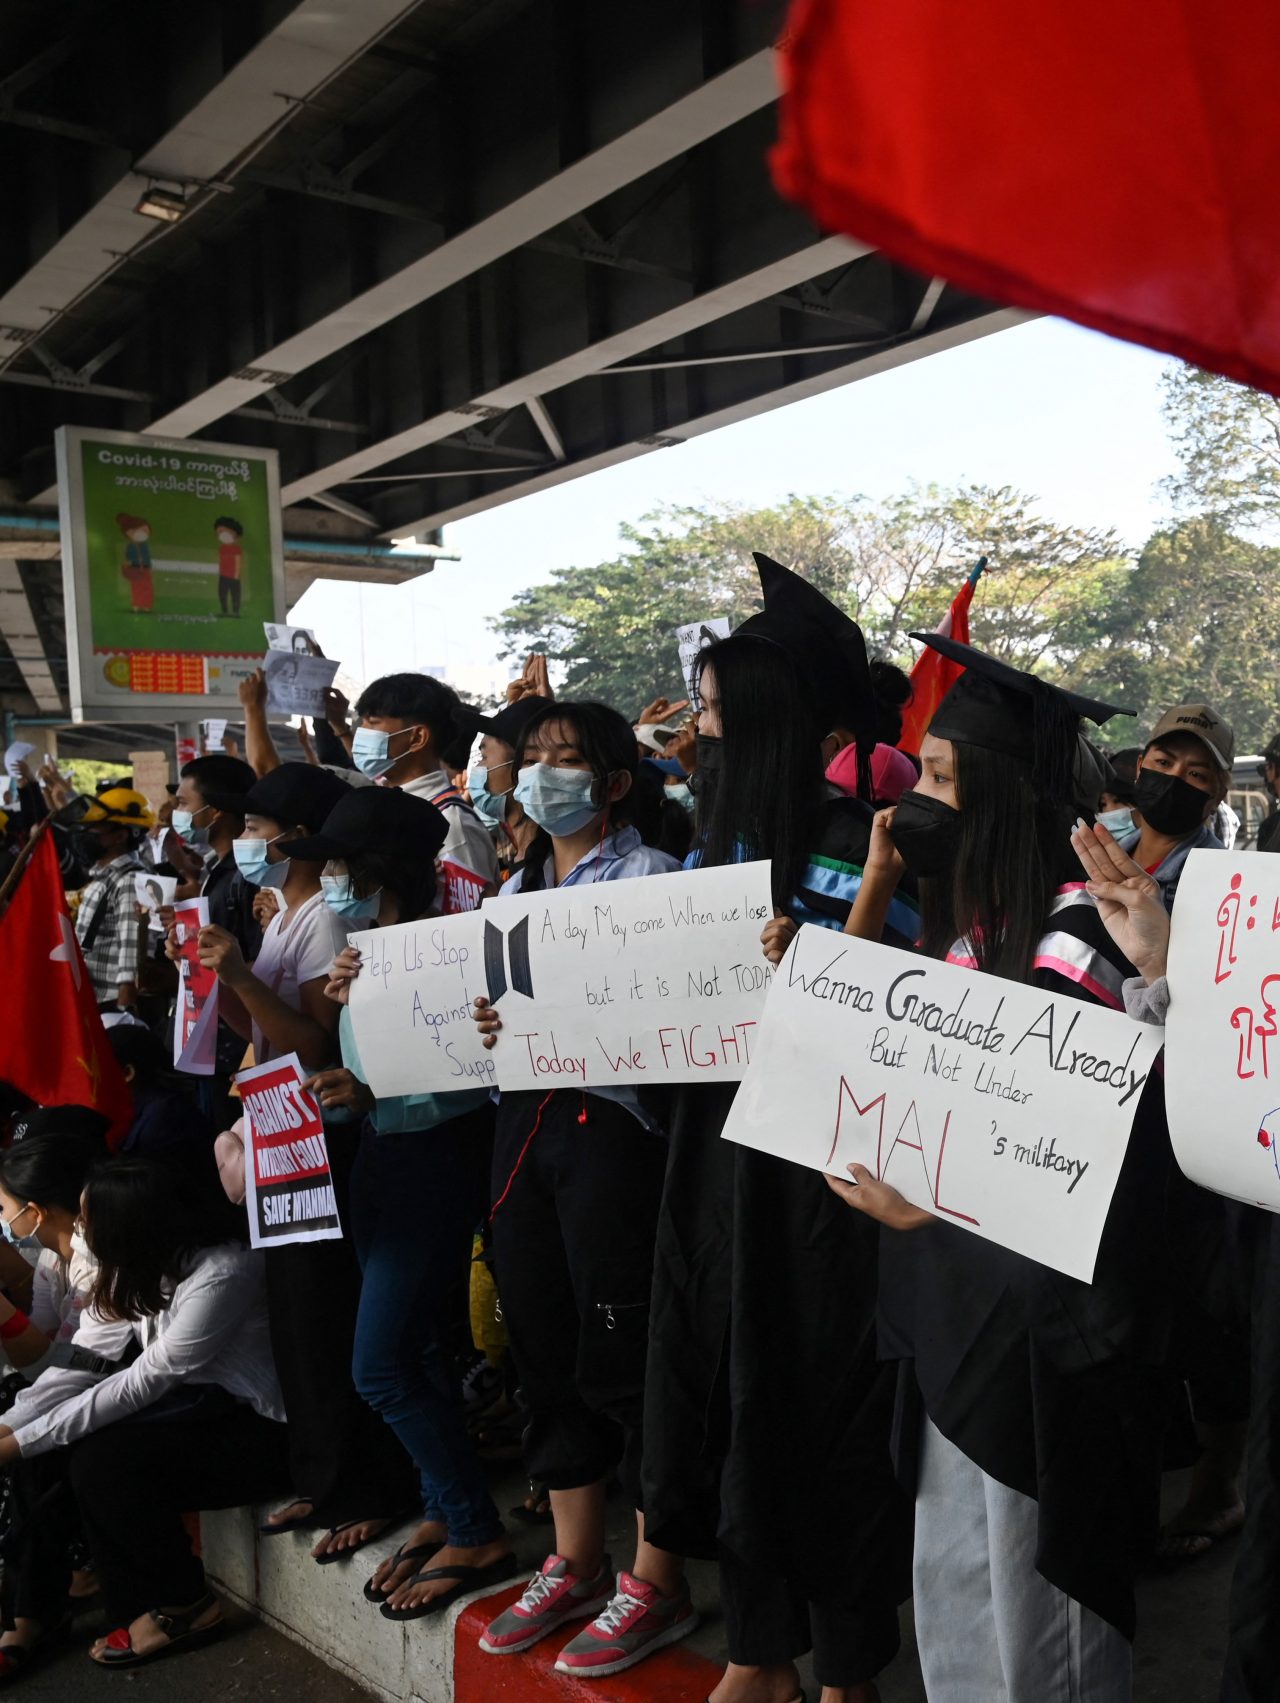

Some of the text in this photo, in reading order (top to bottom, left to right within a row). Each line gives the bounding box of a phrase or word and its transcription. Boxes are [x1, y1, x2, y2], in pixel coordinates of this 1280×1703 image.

[98, 450, 181, 470] Covid-19
[541, 895, 768, 950] A day May come When we lose
[403, 932, 424, 972] Us
[431, 928, 469, 979] Stop
[585, 975, 615, 1006] but
[629, 969, 645, 1001] it
[656, 976, 670, 997] is
[687, 965, 723, 999] Not
[788, 932, 874, 1013] Wanna
[885, 969, 1006, 1053] Graduate
[412, 987, 475, 1040] Against
[514, 1021, 757, 1081] Today We FIGHT
[869, 1026, 1033, 1105] But Not Under
[1014, 1136, 1090, 1195] military
[262, 1193, 291, 1227] SAVE
